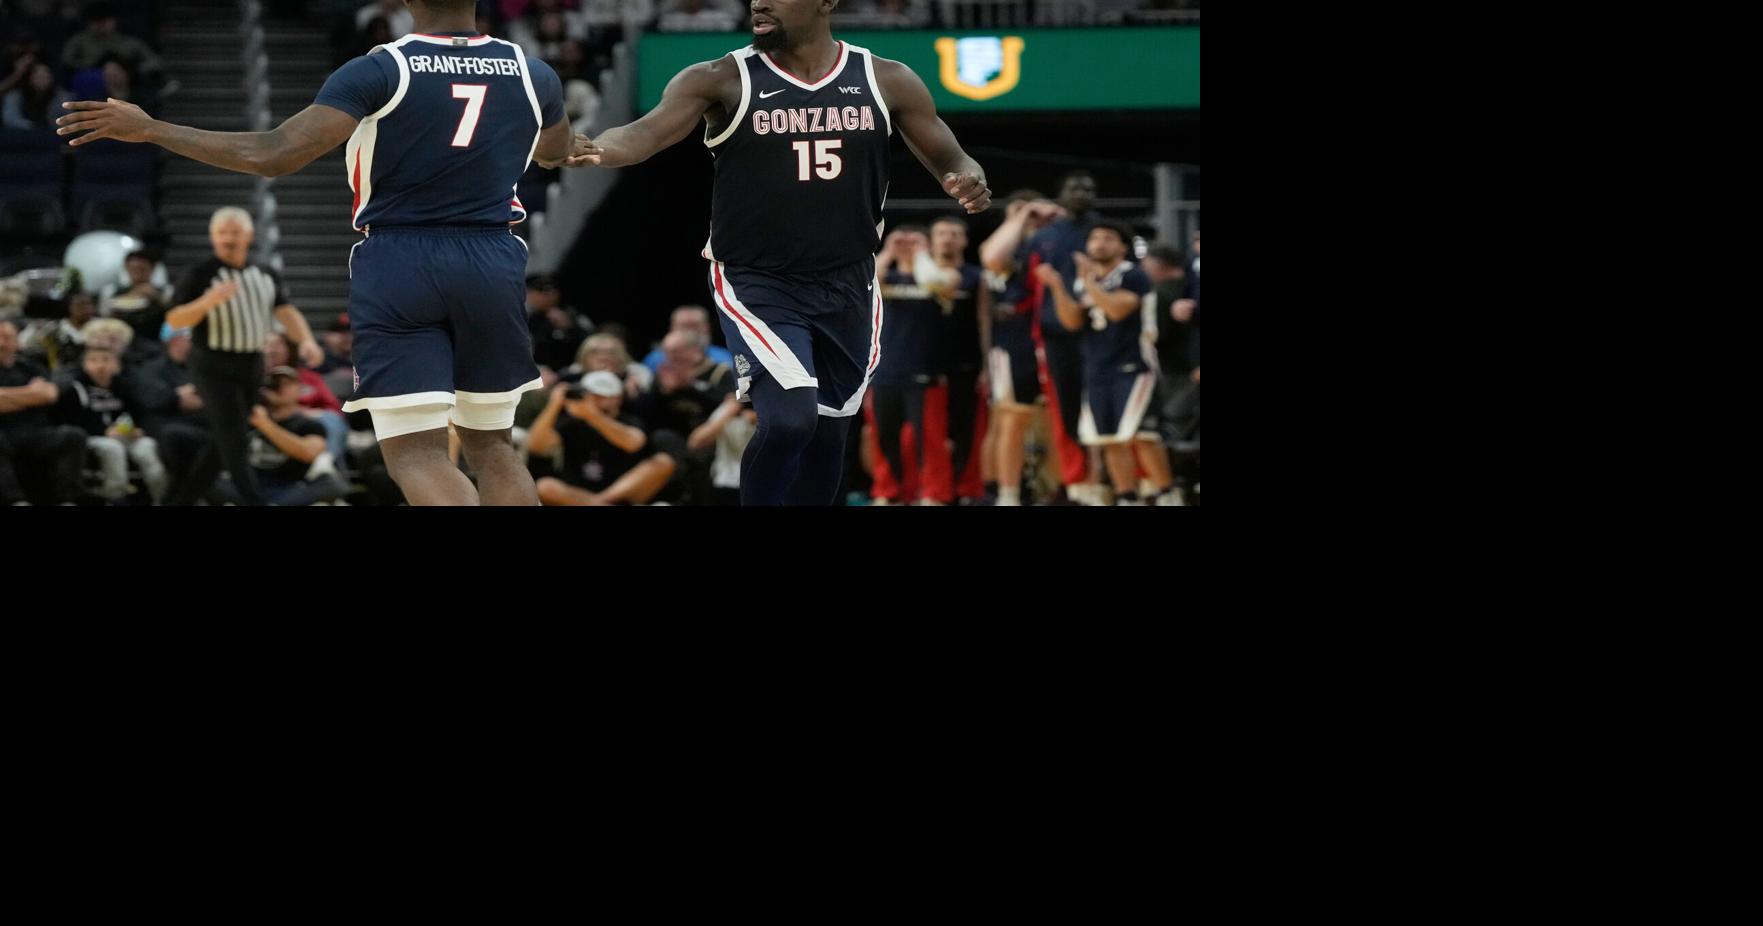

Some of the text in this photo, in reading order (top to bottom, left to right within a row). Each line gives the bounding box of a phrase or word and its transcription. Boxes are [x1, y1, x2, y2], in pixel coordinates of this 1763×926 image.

[408, 54, 521, 77] GRANT-FOSTER
[837, 86, 862, 95] WCC
[449, 83, 489, 148] 7
[752, 105, 876, 135] GONZAGA
[791, 138, 843, 182] 15
